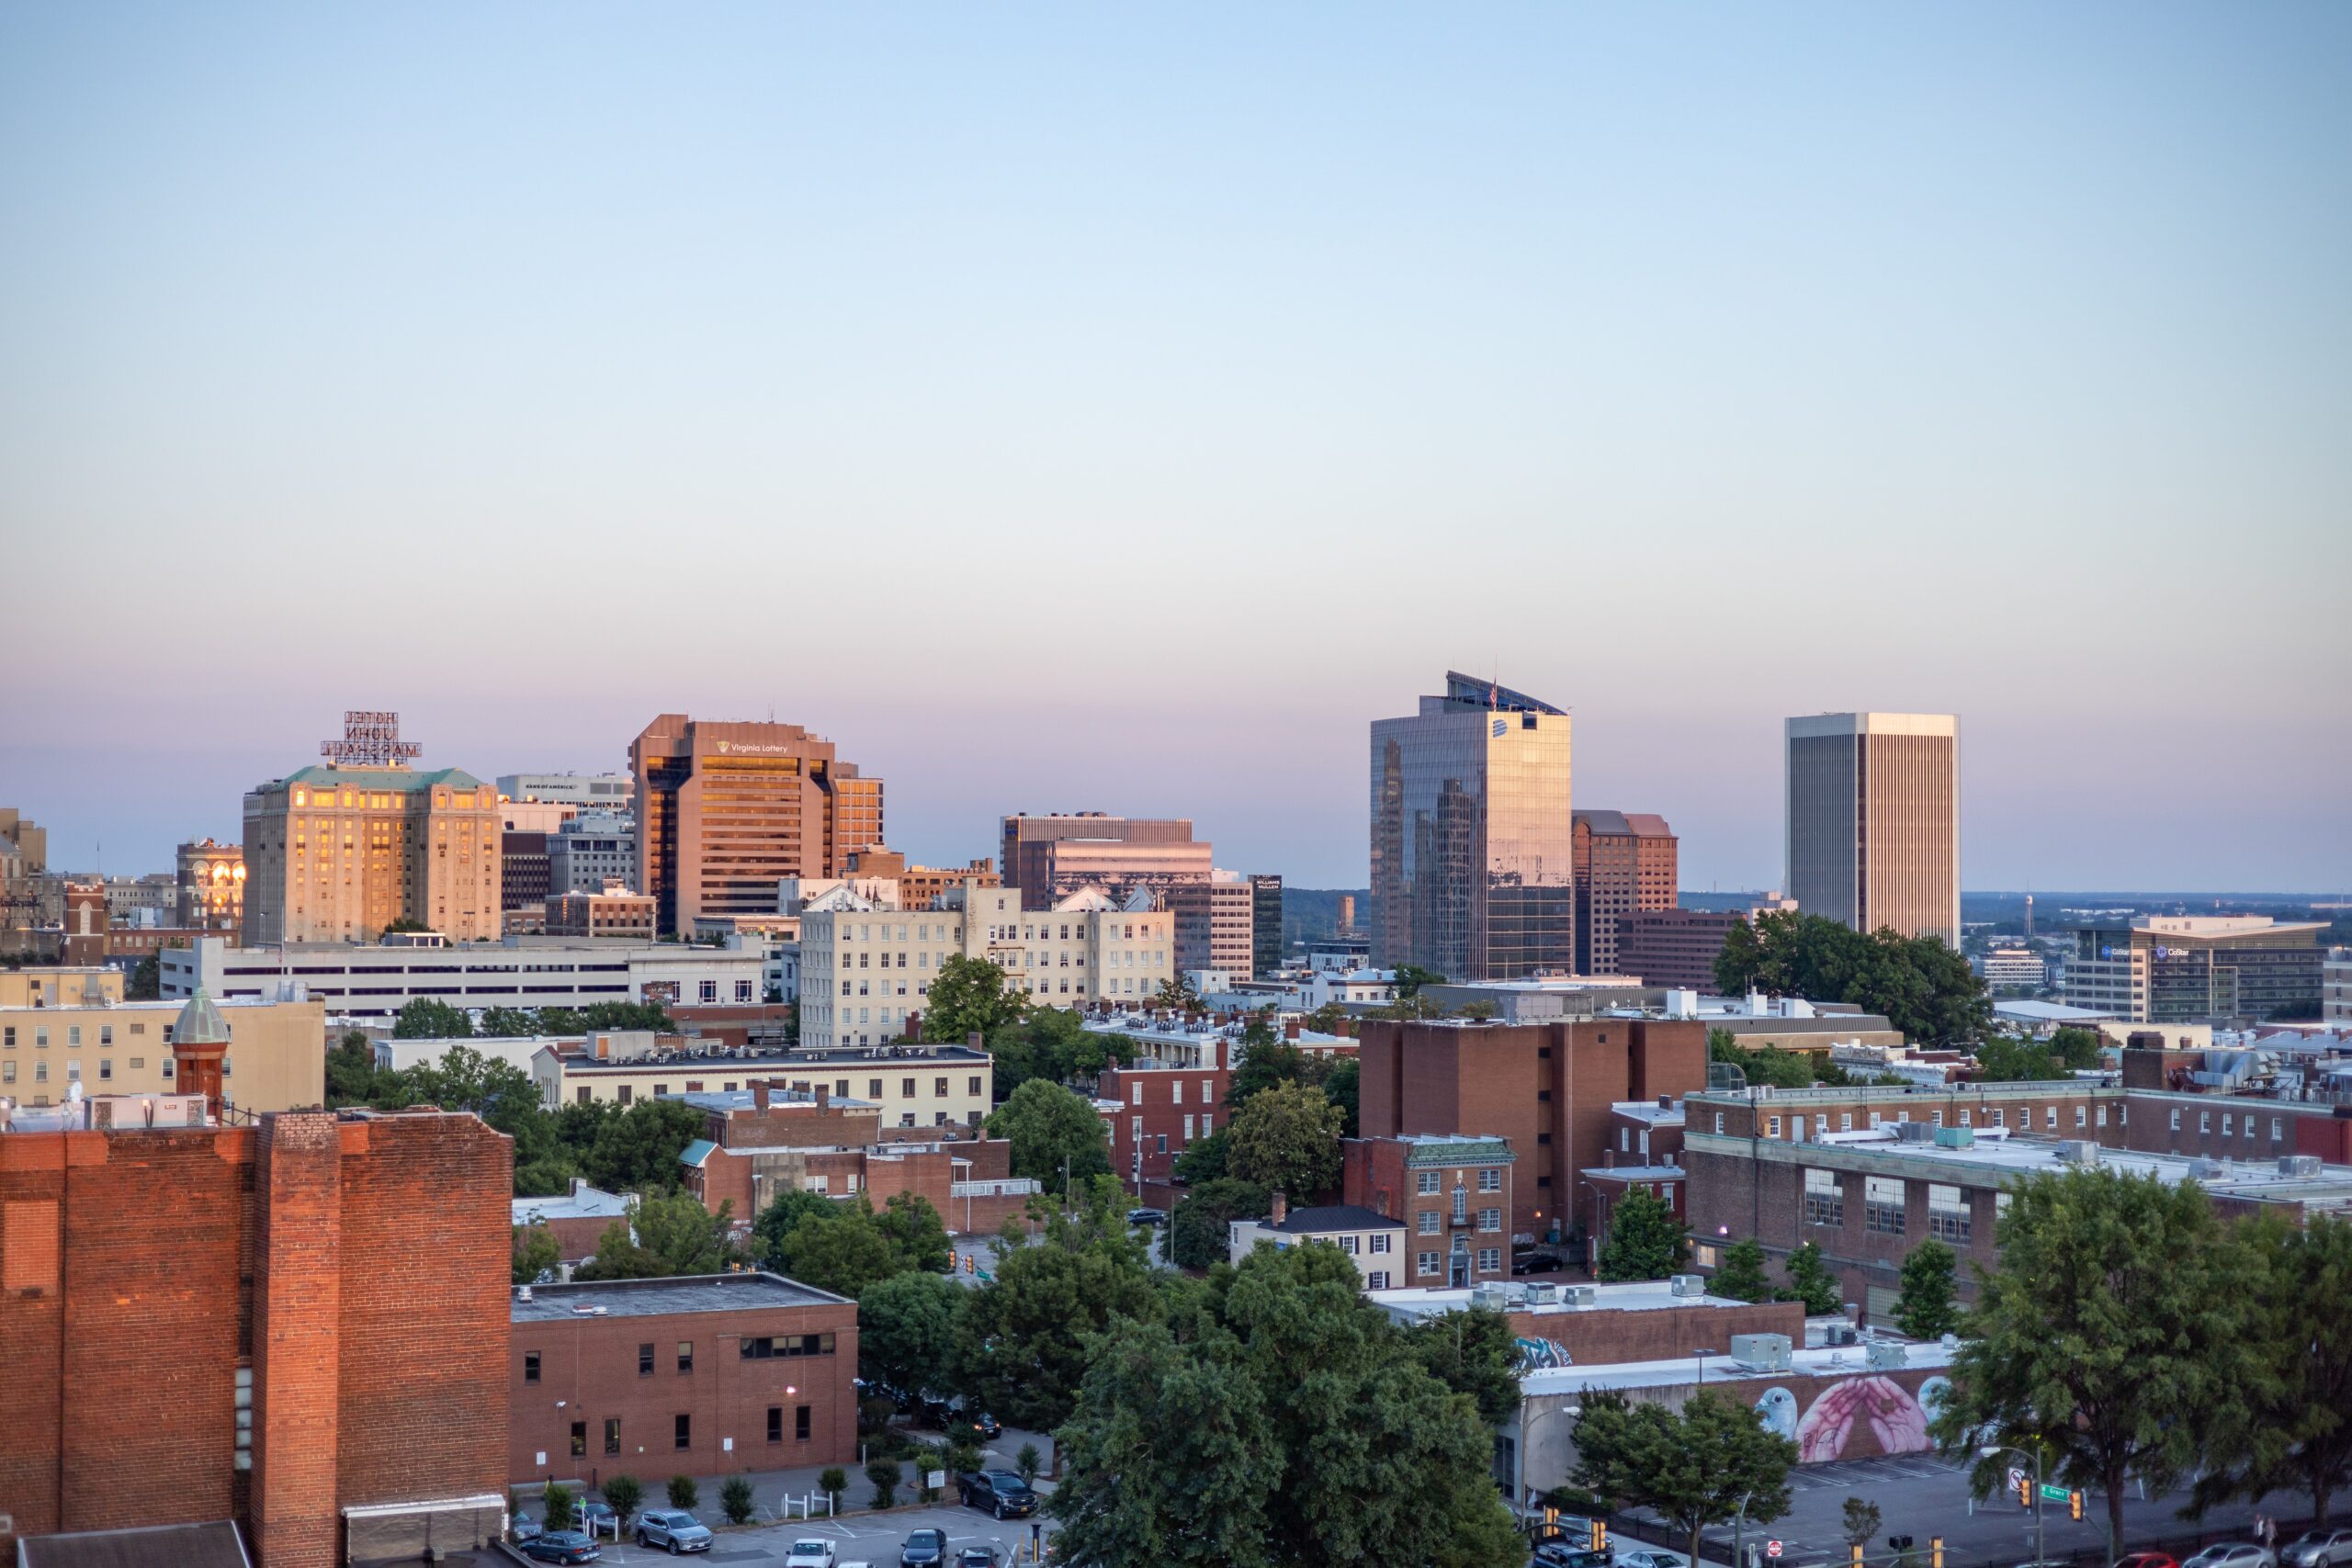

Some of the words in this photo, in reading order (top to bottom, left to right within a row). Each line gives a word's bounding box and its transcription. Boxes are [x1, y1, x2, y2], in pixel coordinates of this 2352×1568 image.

[731, 743, 760, 753] Virginia
[763, 744, 787, 754] Lottery
[2111, 948, 2130, 956] CoStar
[2167, 948, 2189, 956] CoStar
[2049, 1488, 2064, 1497] Grace
